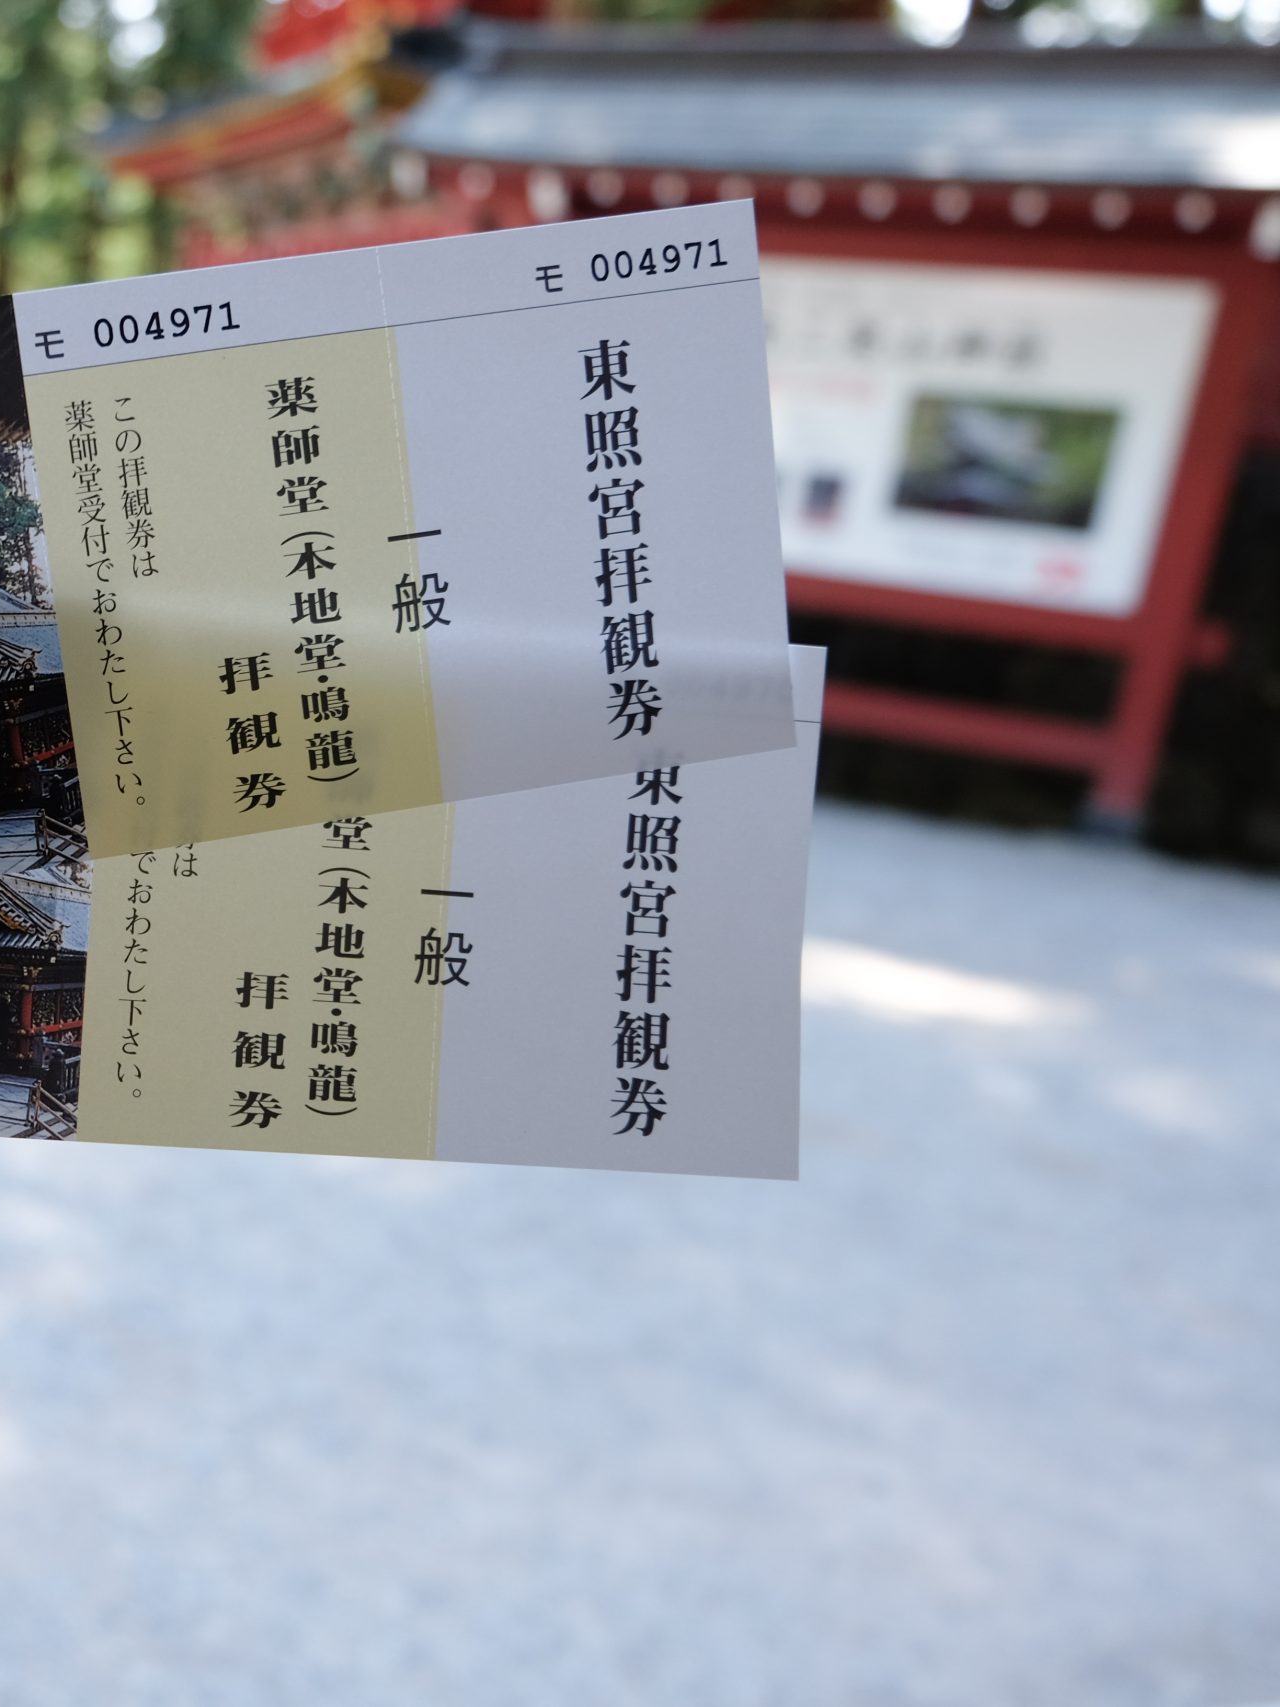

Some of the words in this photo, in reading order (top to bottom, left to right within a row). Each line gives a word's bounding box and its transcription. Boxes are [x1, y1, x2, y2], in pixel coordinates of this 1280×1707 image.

[34, 329, 65, 359] モ
[93, 301, 241, 348] 004971
[536, 264, 563, 292] モ
[590, 238, 728, 282] 004971
[113, 396, 160, 579] この拝観券は
[577, 339, 663, 741] 東照宮拝観券
[63, 400, 146, 806] 薬師堂受付でおわたし下さい。
[387, 529, 451, 634] 一般
[217, 651, 288, 814] 拝観券
[116, 850, 157, 1100] でおわたし下さい。
[304, 815, 373, 1117] 堂（本地堂・鳴龍）
[413, 888, 475, 988] 一般
[609, 752, 683, 1137] 東照宮拝観券
[227, 970, 290, 1130] 拝観券
